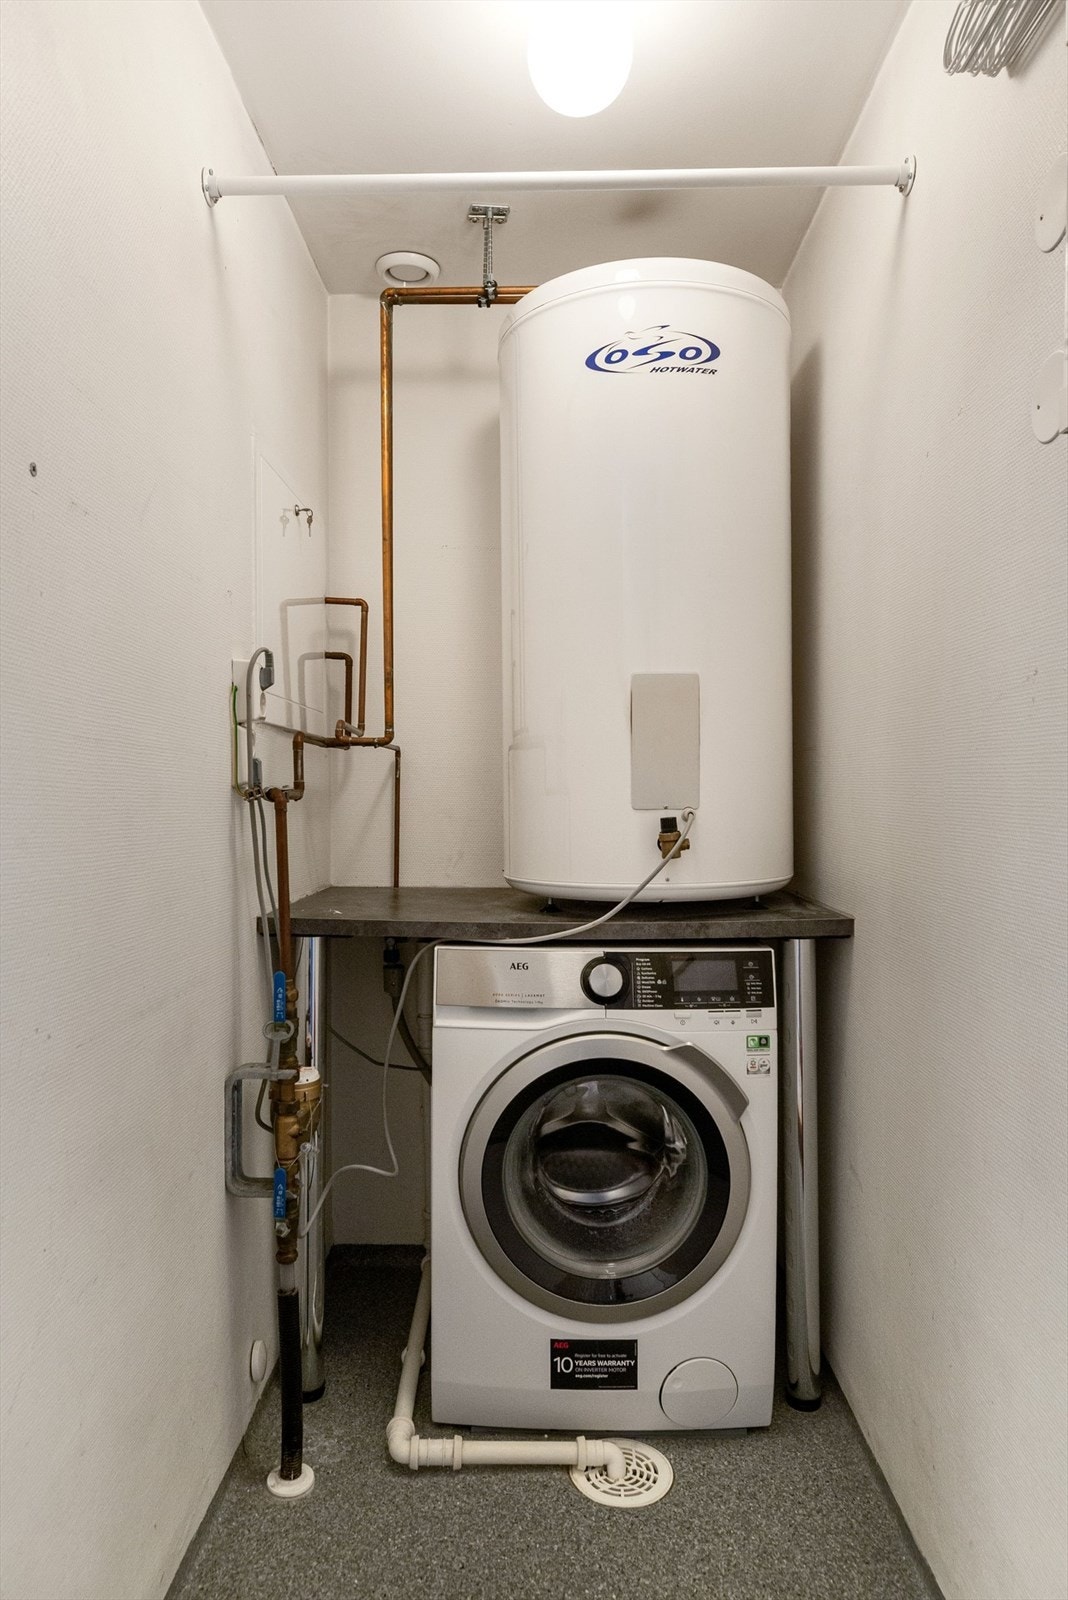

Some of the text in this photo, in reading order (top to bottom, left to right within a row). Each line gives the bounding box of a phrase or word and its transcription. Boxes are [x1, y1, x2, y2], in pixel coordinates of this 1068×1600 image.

[649, 366, 718, 375] HOTWATER
[510, 962, 529, 970] AEG
[554, 1357, 573, 1373] 10
